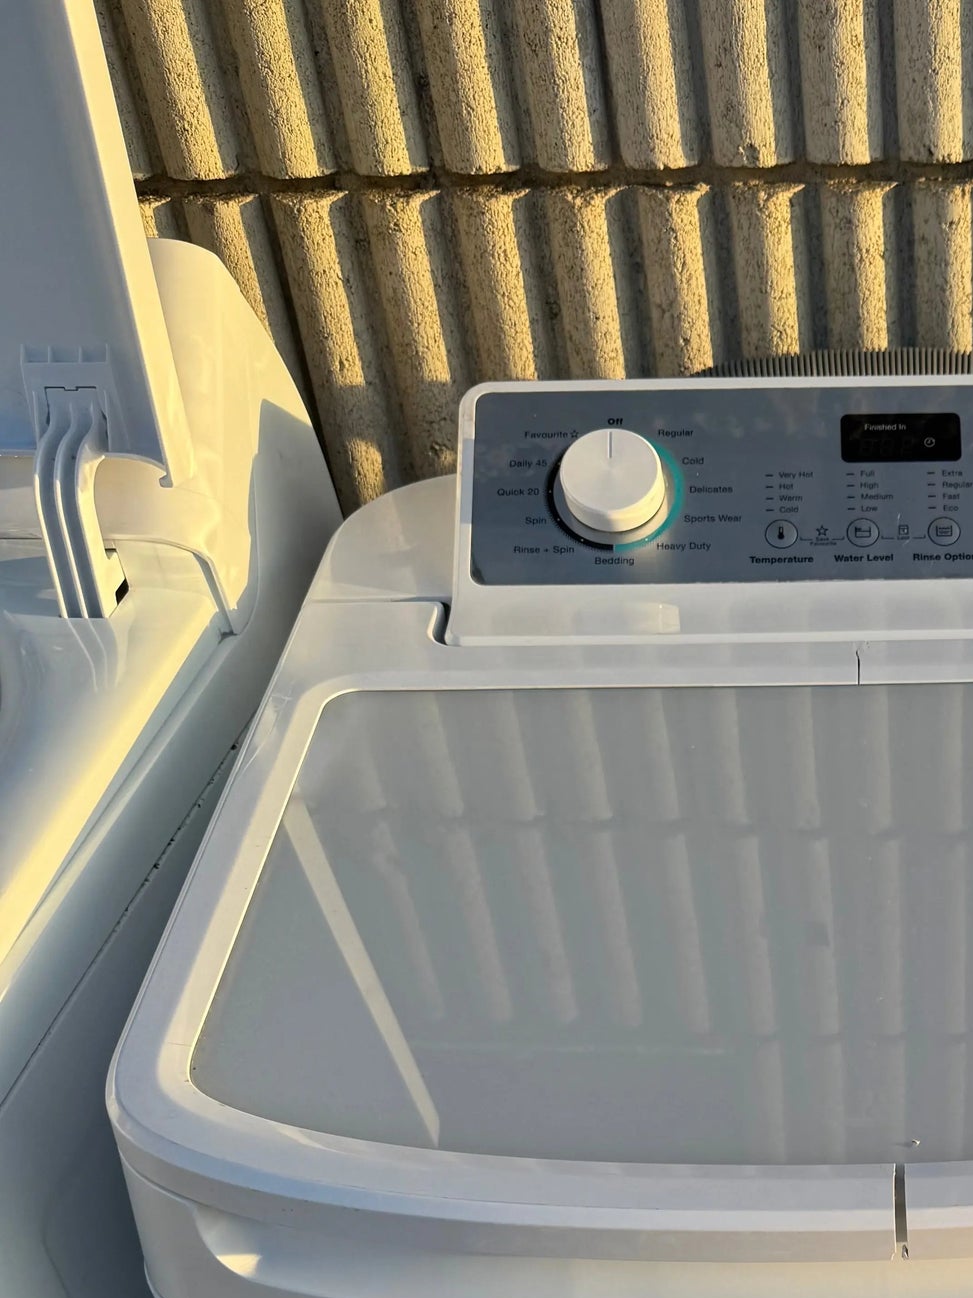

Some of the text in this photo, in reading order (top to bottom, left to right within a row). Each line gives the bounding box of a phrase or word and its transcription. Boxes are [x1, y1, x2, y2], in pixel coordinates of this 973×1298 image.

[607, 418, 624, 426] Off
[863, 423, 897, 431] Finished
[524, 431, 568, 439] Favourite
[657, 429, 694, 438] Regular
[509, 460, 548, 469] Daily 45
[681, 457, 705, 465] Cold
[778, 472, 796, 480] Very
[860, 470, 875, 478] Full
[860, 482, 879, 490] High
[942, 481, 973, 489] Regular
[496, 488, 540, 497] Quick 20
[689, 486, 734, 494] Delicates
[525, 516, 547, 526] Spin
[684, 514, 742, 524] Sports Wear
[513, 546, 541, 554] Rinse
[553, 545, 575, 556] Spin
[656, 542, 712, 552] Heavy Duty
[749, 555, 814, 565] Temperature
[834, 554, 894, 563] Water Level
[912, 553, 941, 561] Rinse
[594, 557, 635, 566] Bedding
